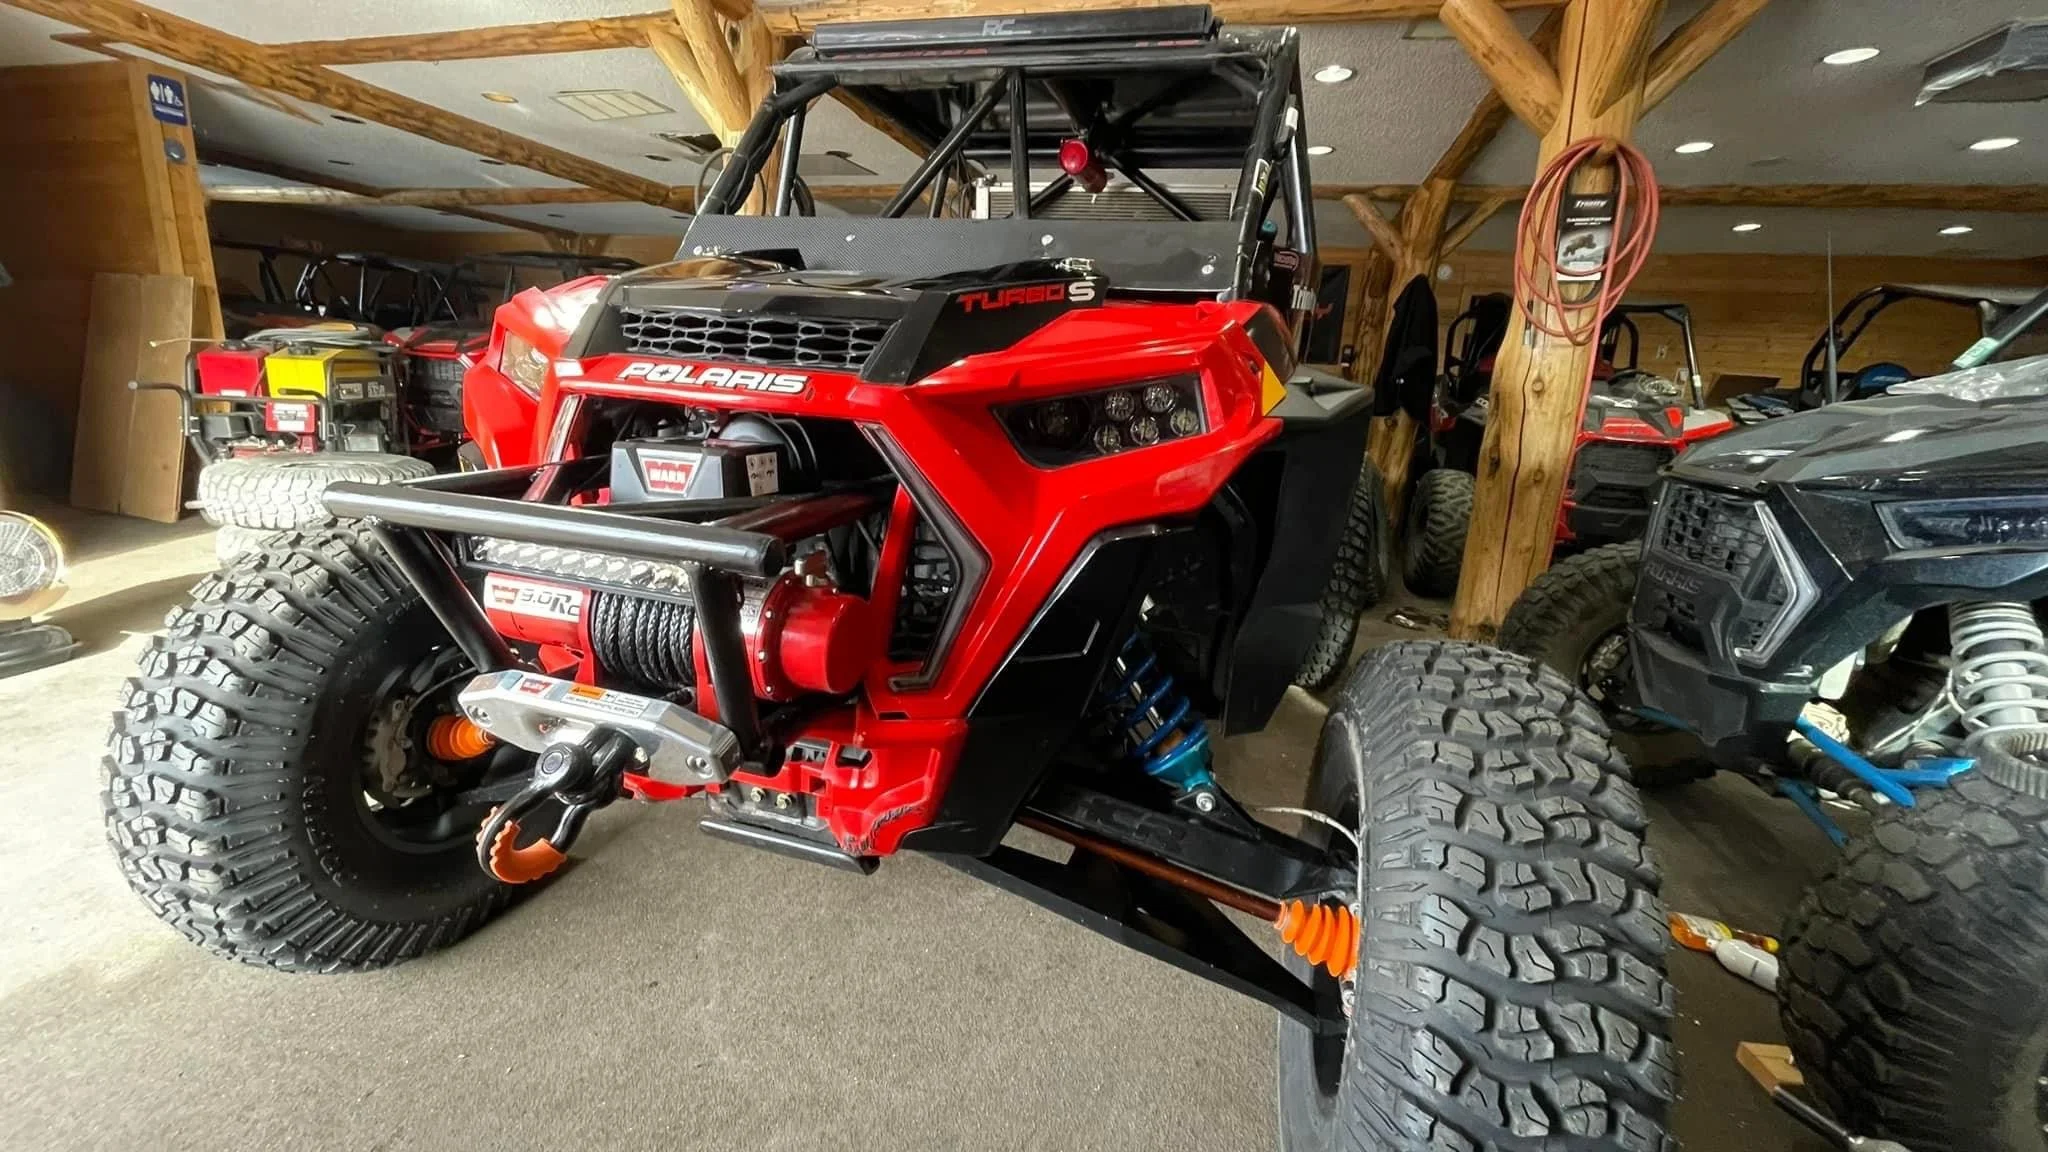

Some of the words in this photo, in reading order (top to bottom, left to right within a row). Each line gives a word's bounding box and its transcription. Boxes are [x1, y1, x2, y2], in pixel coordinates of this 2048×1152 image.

[956, 282, 1065, 313] TURBO
[1068, 280, 1096, 302] S
[617, 361, 808, 394] POLARIS
[648, 467, 686, 483] WARN
